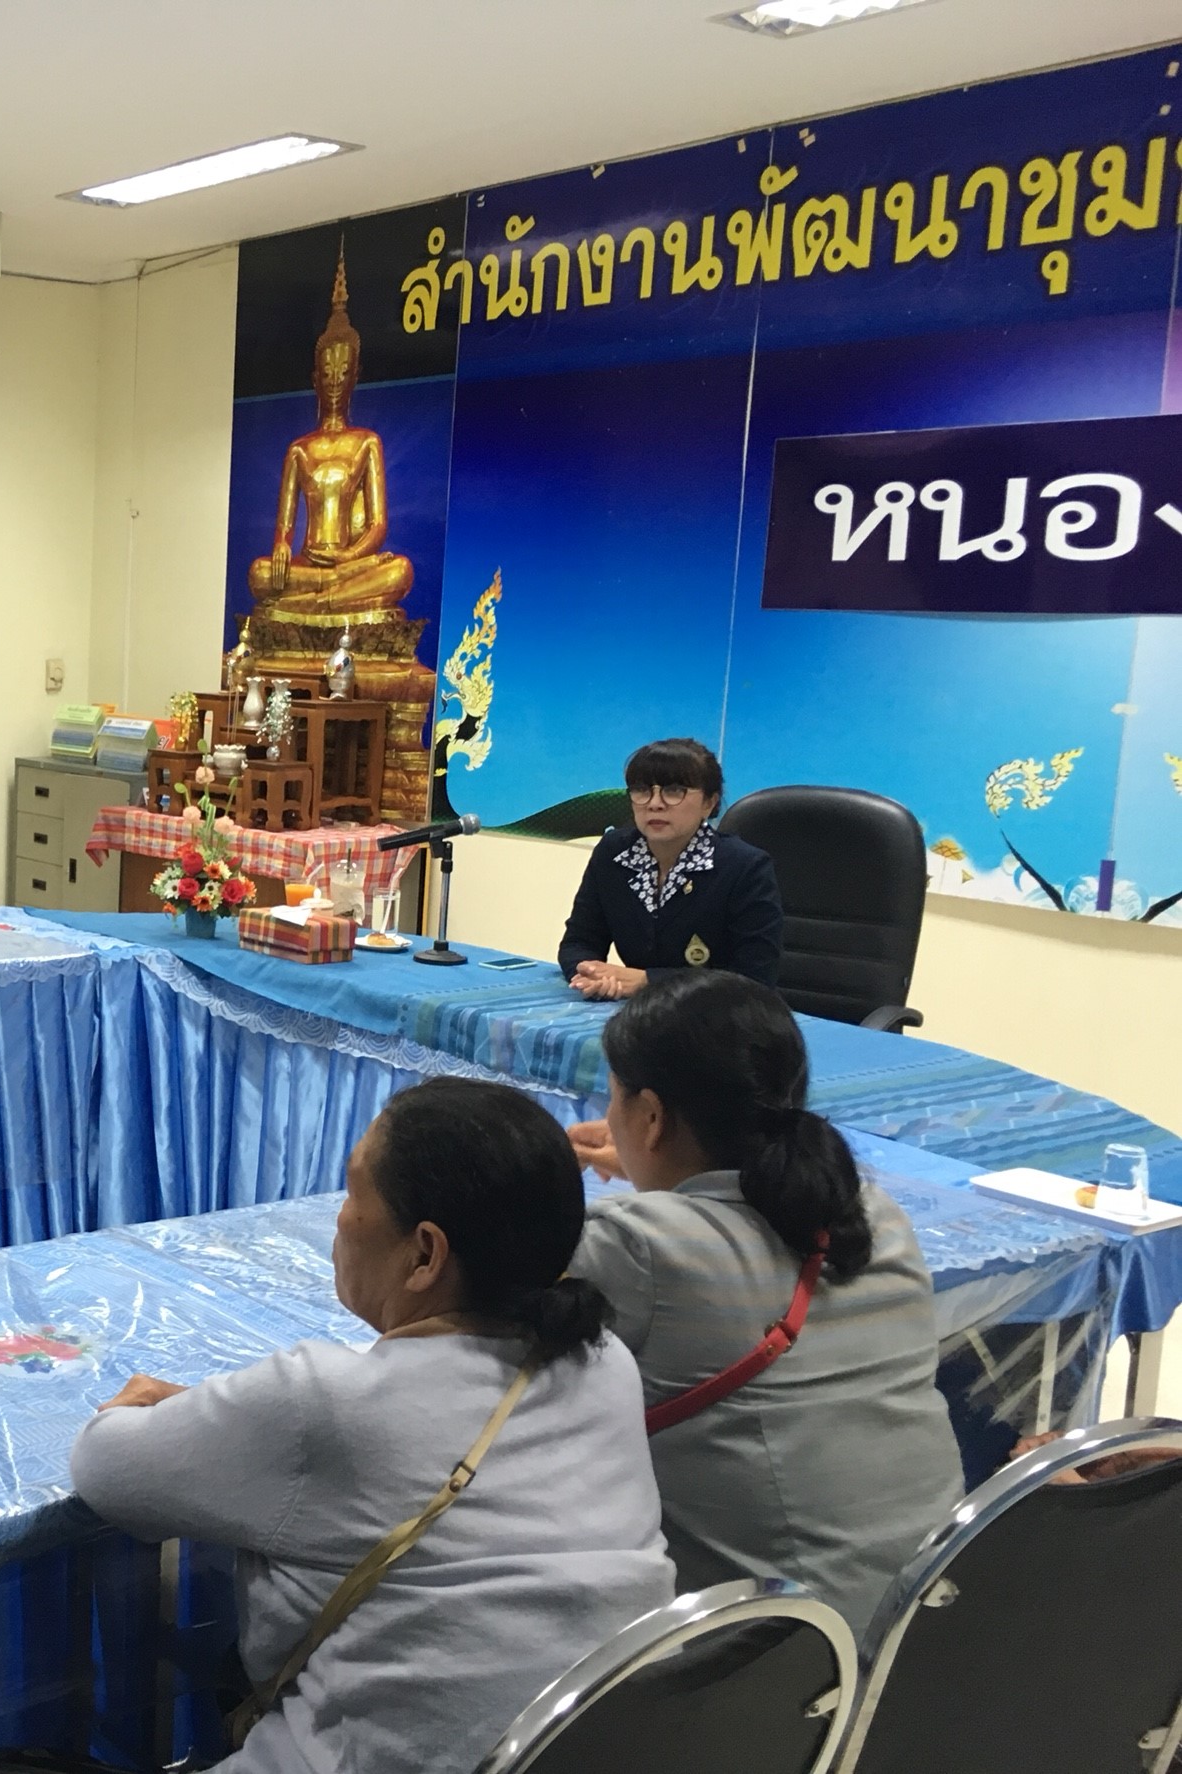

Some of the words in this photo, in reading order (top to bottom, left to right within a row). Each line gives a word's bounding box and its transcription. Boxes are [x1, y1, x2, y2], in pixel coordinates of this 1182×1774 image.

[401, 136, 1182, 334] สำนักงานพัฒนาชุม
